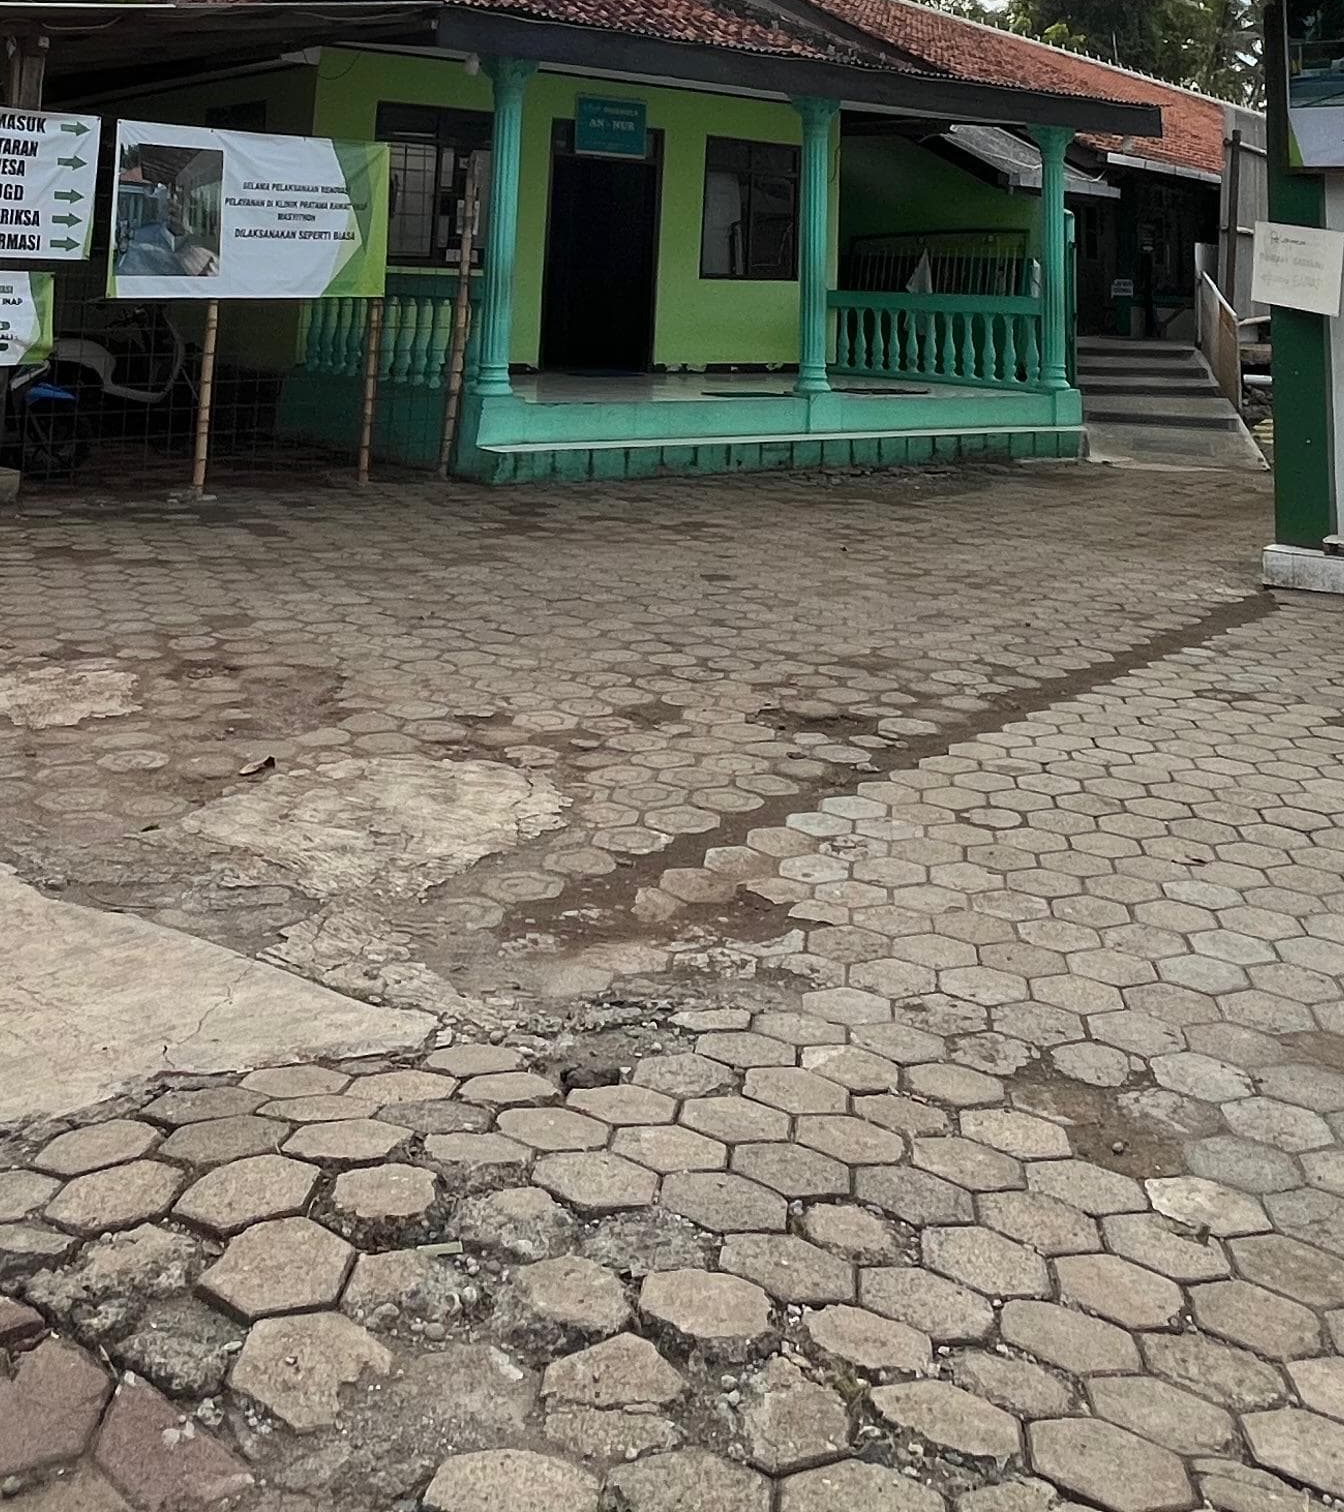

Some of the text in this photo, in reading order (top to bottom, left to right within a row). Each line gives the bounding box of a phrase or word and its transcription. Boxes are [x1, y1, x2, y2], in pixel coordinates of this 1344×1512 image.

[224, 198, 265, 207] PELAYANAN
[234, 228, 355, 241] DILAKSANAKAN SEPERTI BIASA
[2, 298, 23, 306] INAP
